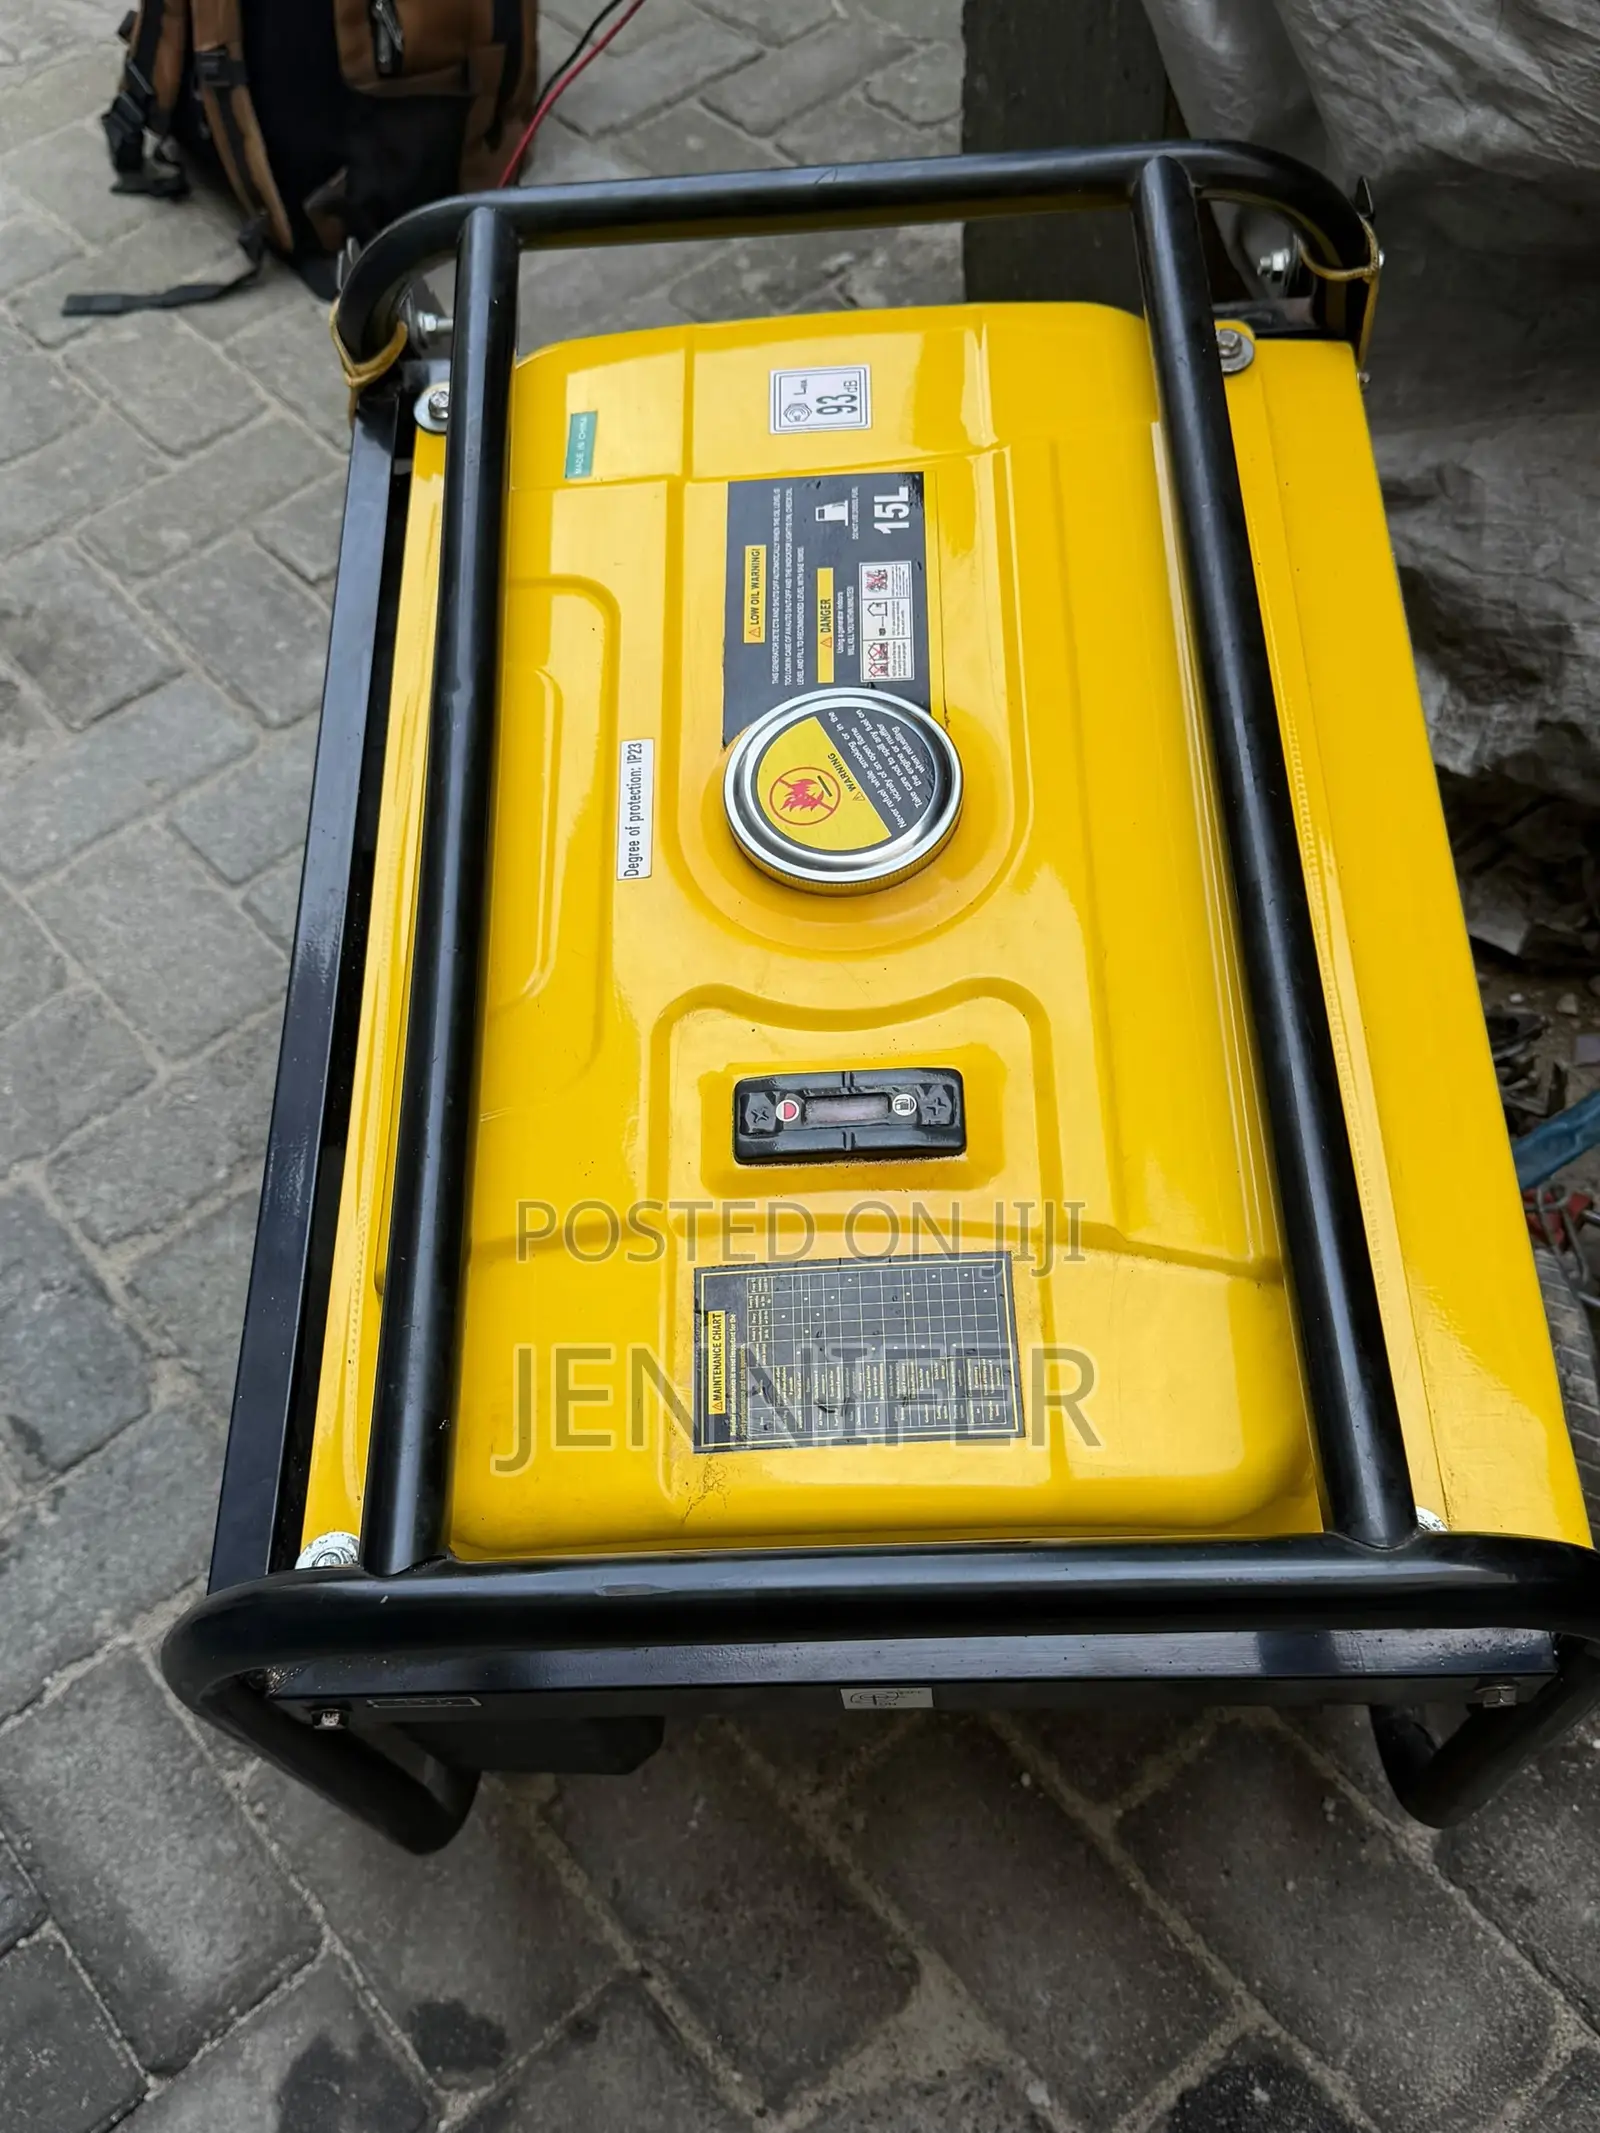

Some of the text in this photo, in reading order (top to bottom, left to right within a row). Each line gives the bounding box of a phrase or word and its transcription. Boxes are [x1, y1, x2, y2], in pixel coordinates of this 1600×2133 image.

[816, 380, 858, 415] 93 dB
[574, 452, 584, 474] MADE
[577, 442, 586, 450] IN
[874, 486, 910, 534] 15L
[750, 548, 760, 625] LOW OIL WARNING!
[820, 599, 831, 633] DANGER
[828, 712, 838, 723] the
[836, 723, 844, 732] in
[848, 741, 869, 769] smoking
[851, 727, 902, 802] vicinity of an open flame
[856, 709, 922, 808] Take care not to spill any fuel on
[876, 724, 922, 786] the engine or muffler
[891, 726, 925, 773] when refuelling
[827, 753, 856, 792] WARNING
[866, 770, 880, 788] while
[624, 743, 644, 876] Degree of protection: IP23
[877, 789, 894, 808] refuel
[890, 808, 907, 828] Never
[711, 1314, 722, 1401] MAINTENANCE CHART
